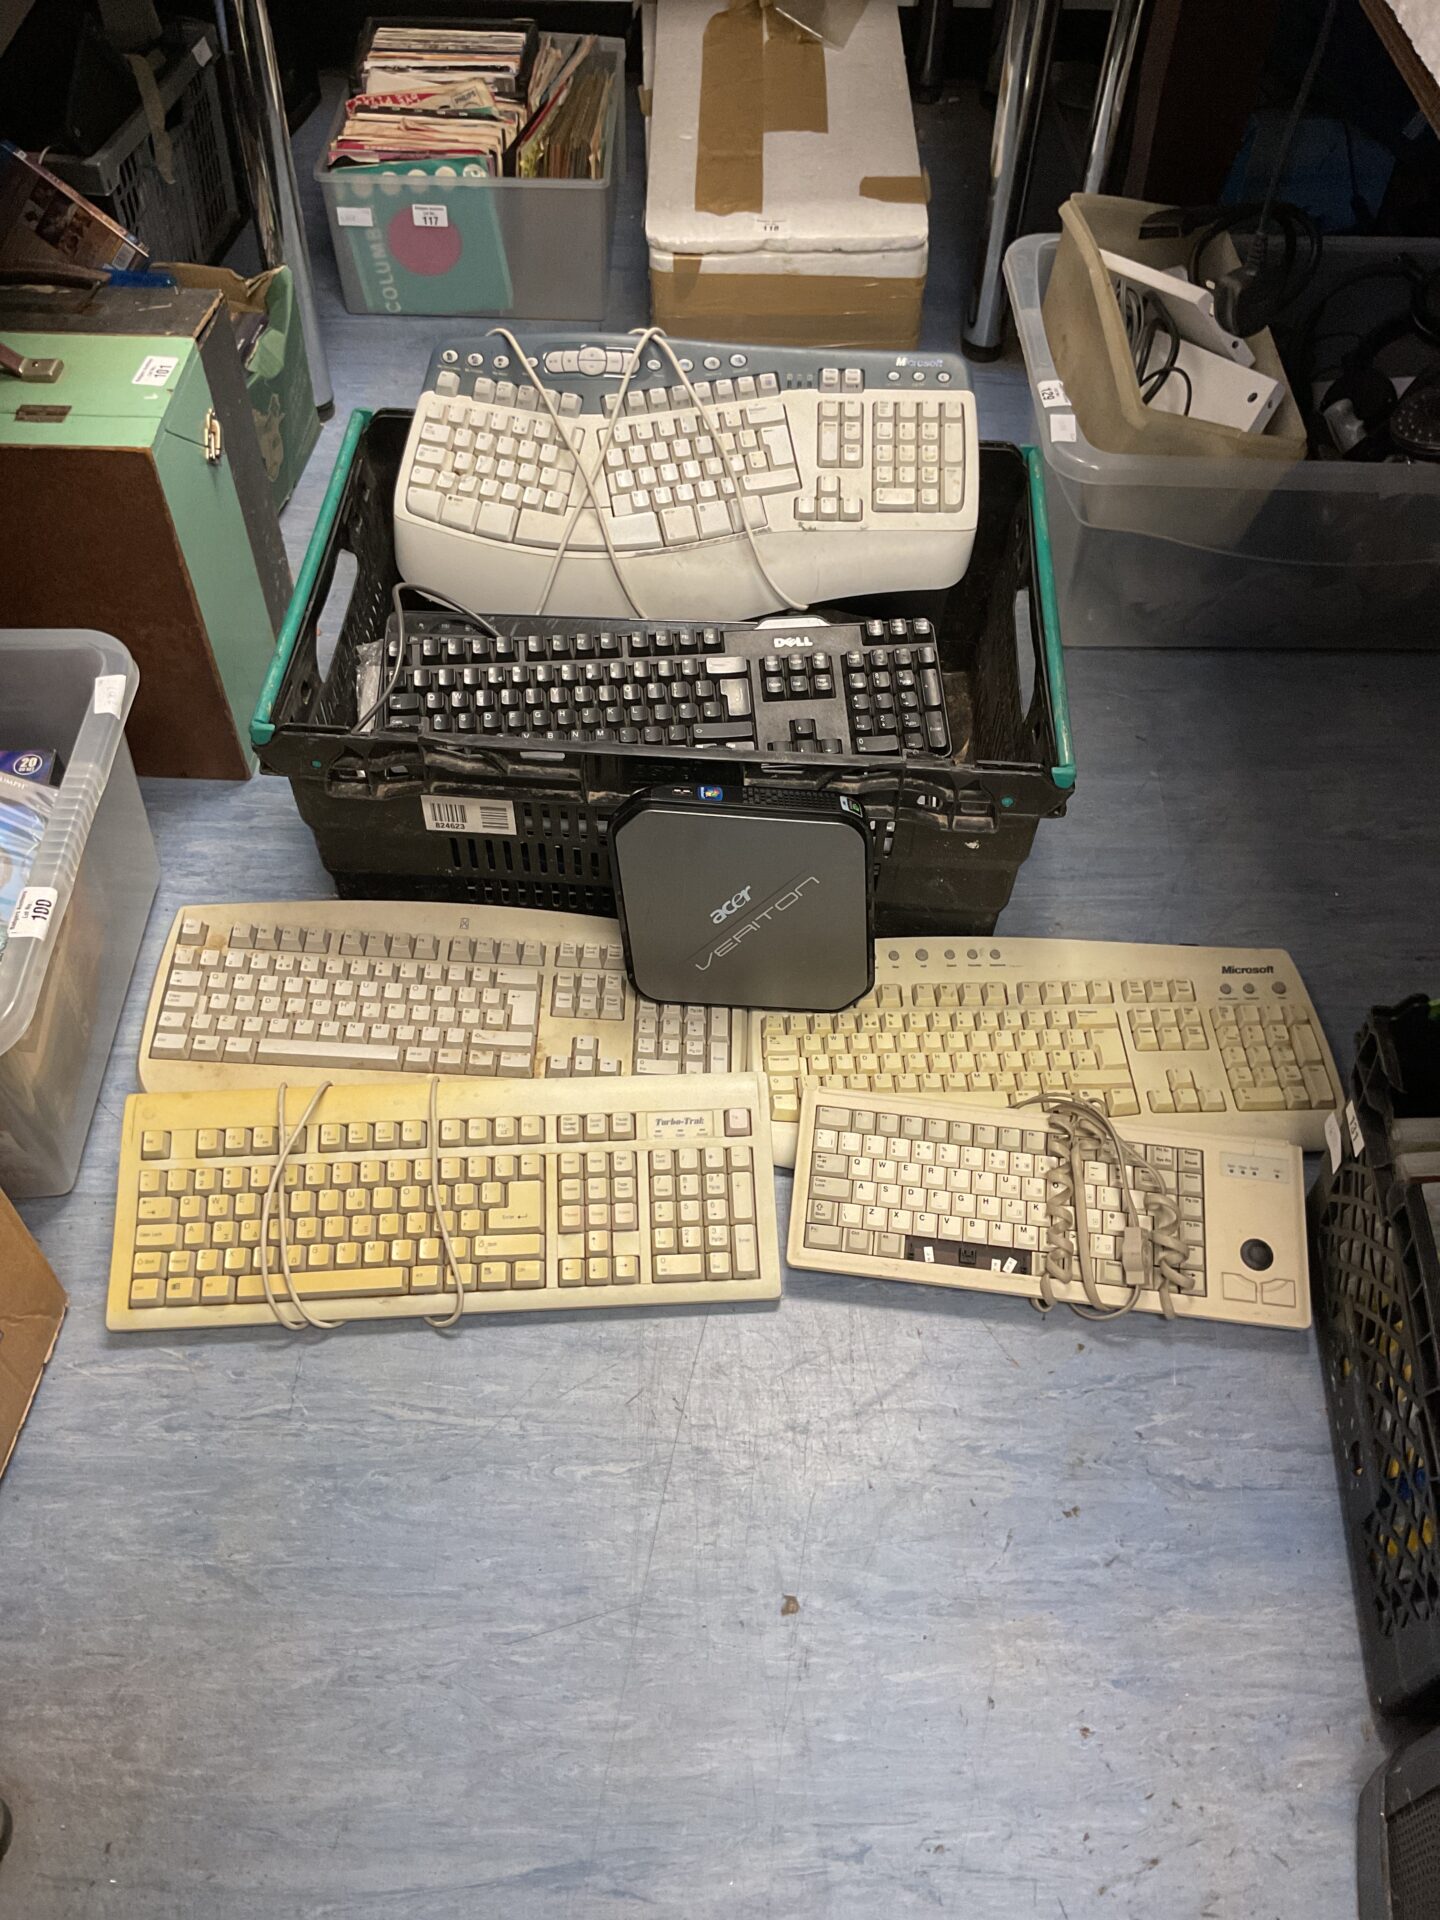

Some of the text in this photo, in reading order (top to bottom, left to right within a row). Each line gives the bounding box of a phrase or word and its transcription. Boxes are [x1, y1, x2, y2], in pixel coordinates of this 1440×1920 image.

[423, 217, 438, 225] 117
[365, 227, 401, 313] COLUMB
[154, 365, 172, 378] 101
[1041, 388, 1055, 400] 129
[774, 637, 813, 648] DELL
[20, 757, 38, 768] 20
[435, 822, 466, 830] 824623
[31, 898, 52, 920] 100
[710, 885, 751, 924] acer
[695, 876, 820, 970] VERITON
[1221, 966, 1274, 974] Microsoft
[655, 1117, 704, 1126] Turbo-Trak
